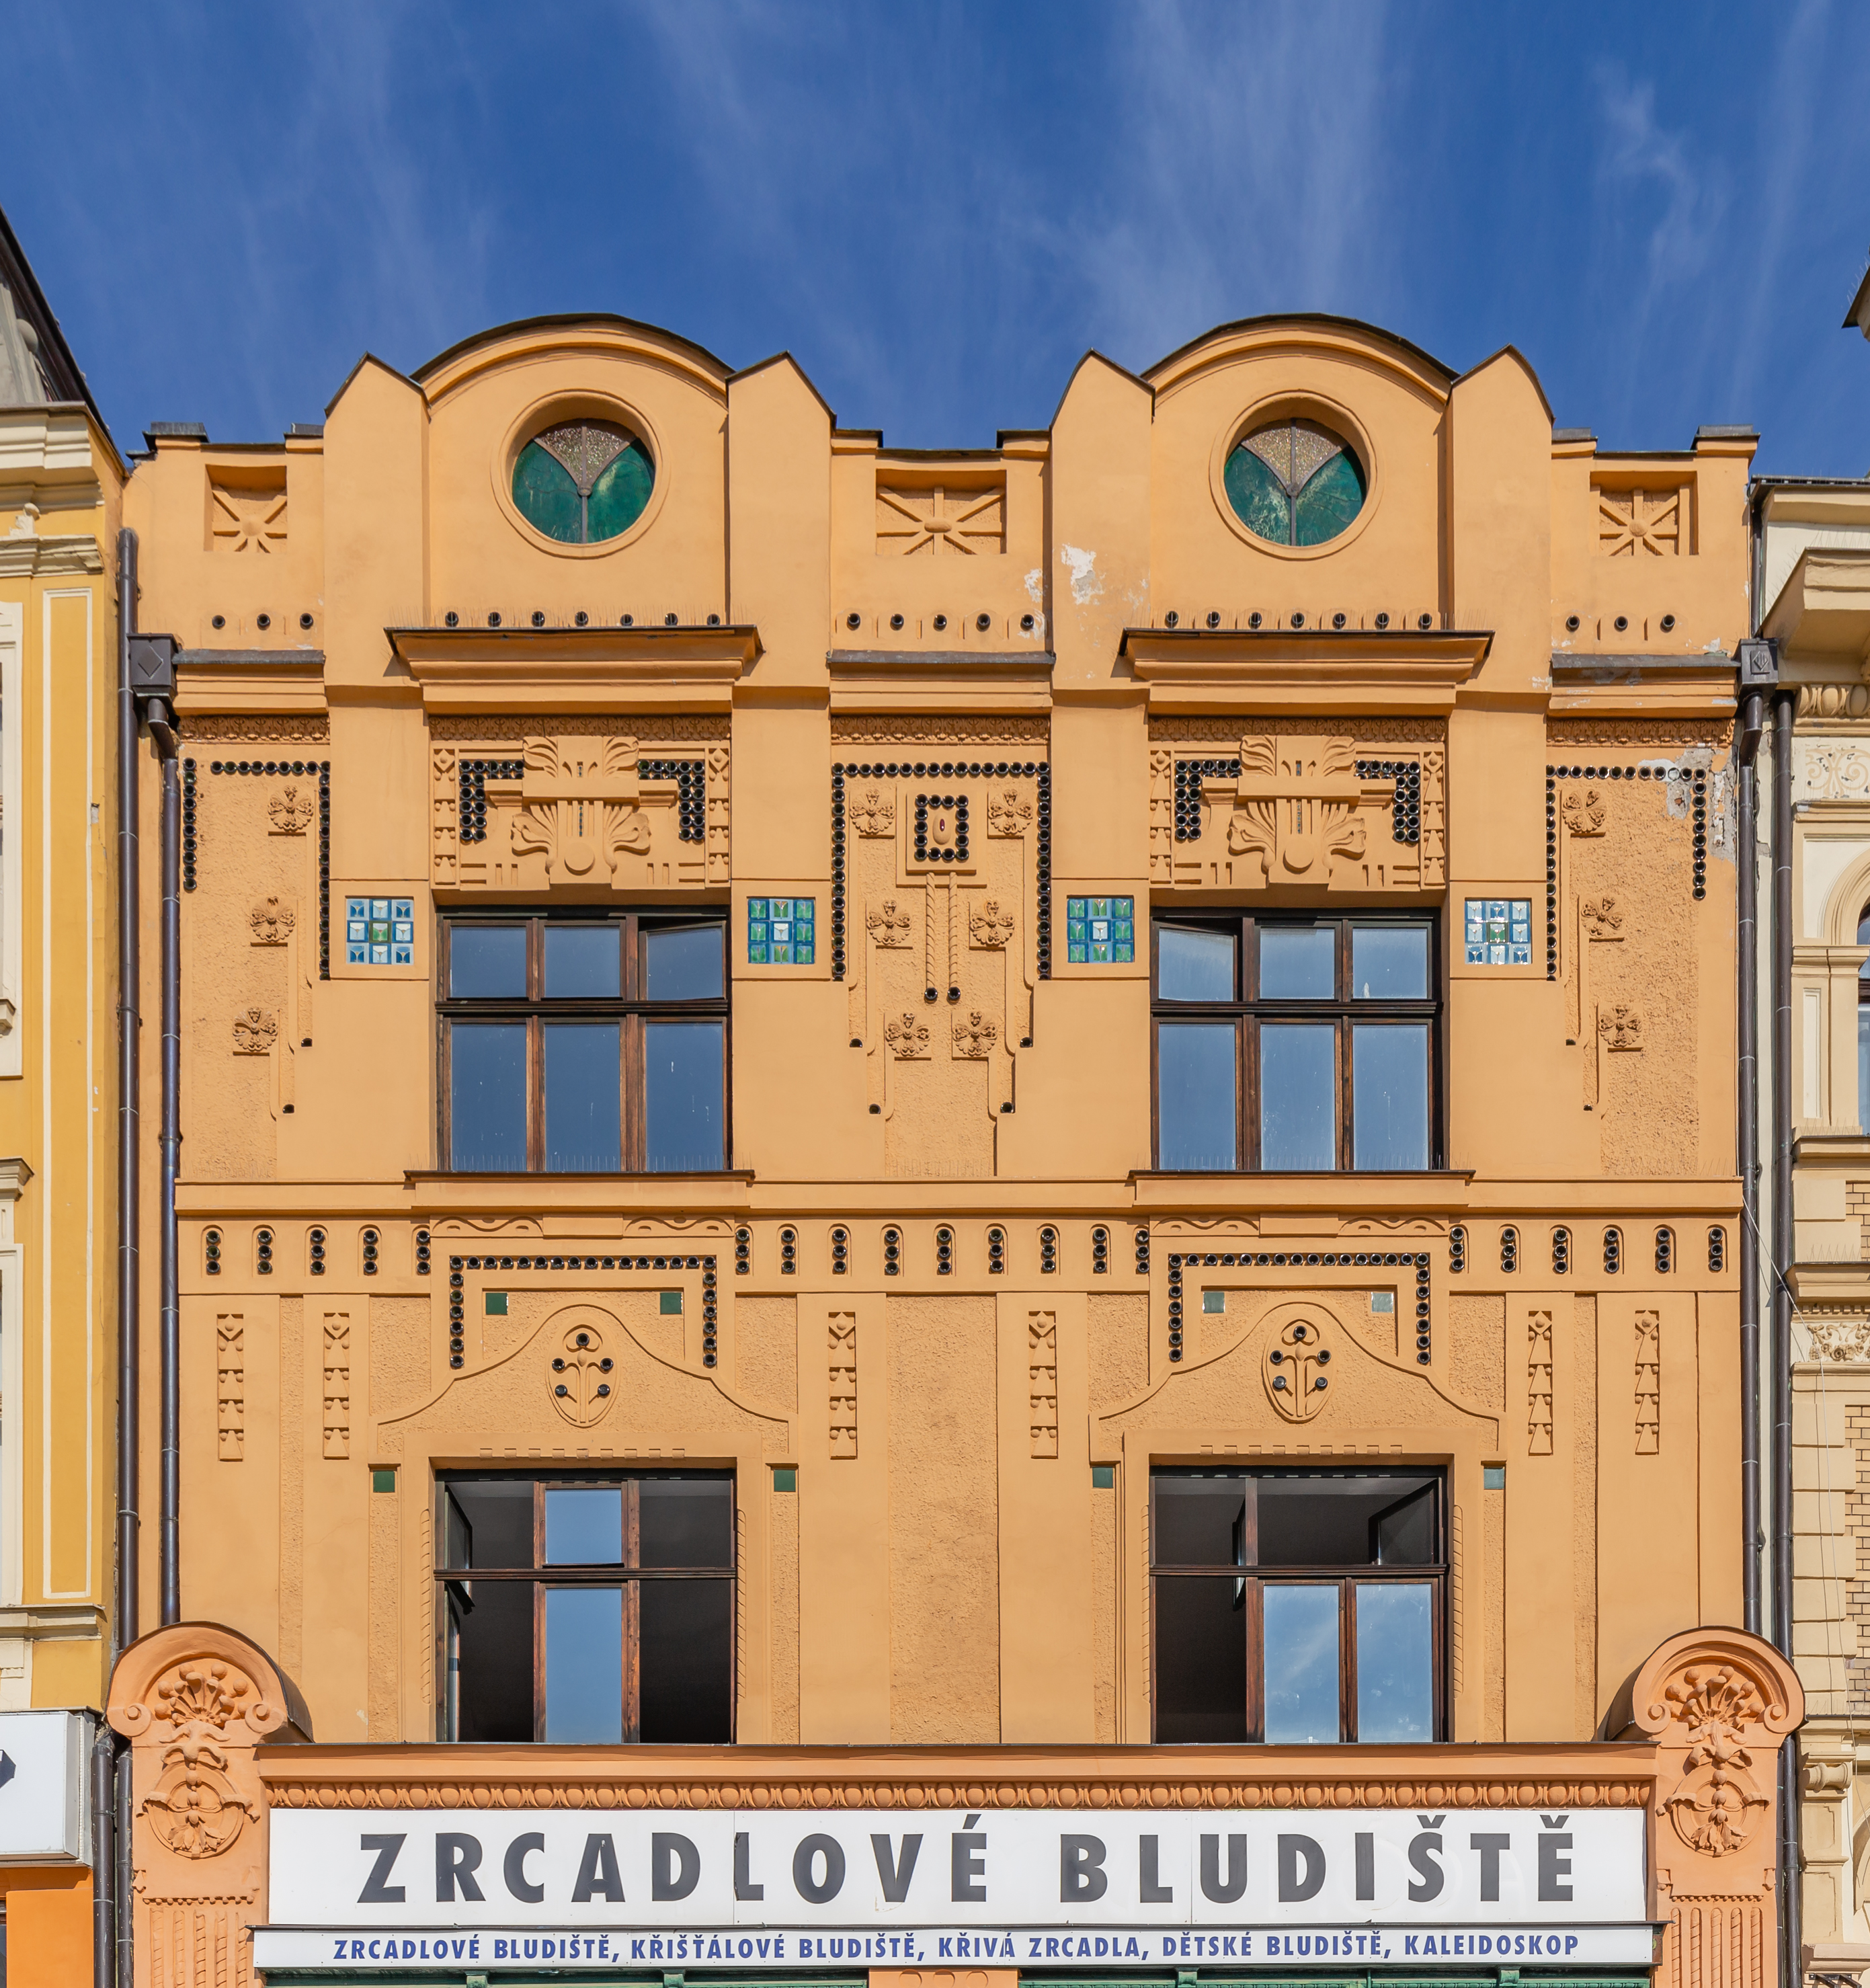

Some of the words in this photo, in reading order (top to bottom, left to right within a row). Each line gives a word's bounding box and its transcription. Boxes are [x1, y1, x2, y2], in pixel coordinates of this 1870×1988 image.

[357, 1813, 987, 1904] ZRCADLOVÉ
[1060, 1815, 1574, 1904] BLUDIŠTĚ
[333, 1934, 479, 1959] ZRCADLOVÉ
[494, 1934, 619, 1962] BLUDIŠTĚ,
[632, 1933, 784, 1959] KŘIŠŤÁLOVÉ
[799, 1932, 925, 1962] BLUDIŠTĚ,
[939, 1932, 1016, 1958] KŘIVÁ
[1028, 1937, 1149, 1960] ZRCADLA,
[1163, 1932, 1252, 1956] DĚTSKÉ
[1267, 1930, 1391, 1959] BLUDIŠTĚ,
[1405, 1935, 1578, 1955] KALEIDOSKOP
